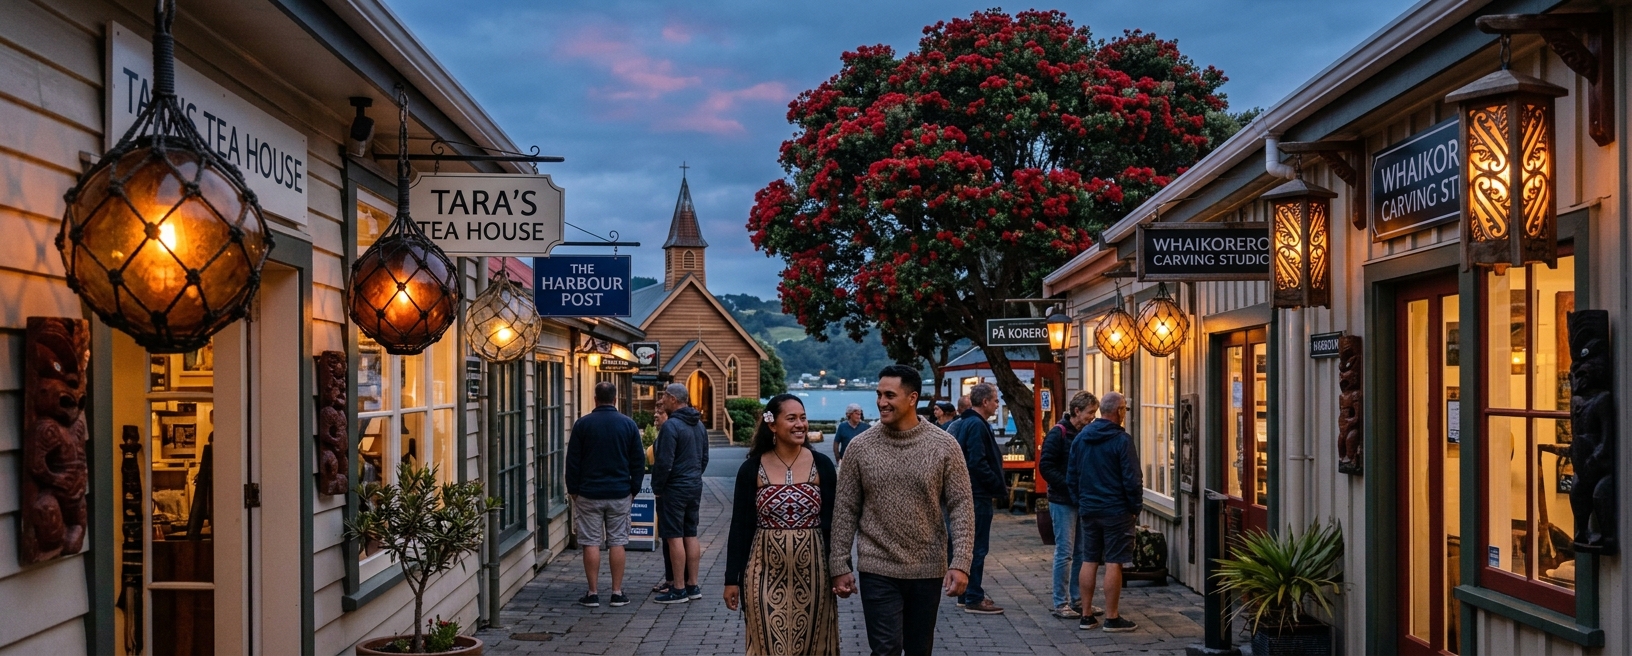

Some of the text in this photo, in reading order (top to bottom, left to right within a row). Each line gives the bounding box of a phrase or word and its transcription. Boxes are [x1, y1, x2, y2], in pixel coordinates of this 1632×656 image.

[203, 110, 241, 166] TEA
[246, 133, 303, 194] HOUSE
[1381, 138, 1460, 194] WHAIKOR
[430, 189, 537, 216] TARA’S
[1381, 183, 1437, 222] CARVING
[416, 221, 544, 241] TEA HOUSE
[1153, 237, 1269, 252] WHAIKORERO
[1153, 254, 1269, 266] CARVING STUDIO
[570, 263, 595, 274] THE
[541, 276, 623, 291] HARBOUR
[561, 292, 604, 306] POST
[1008, 327, 1048, 339] KORERO
